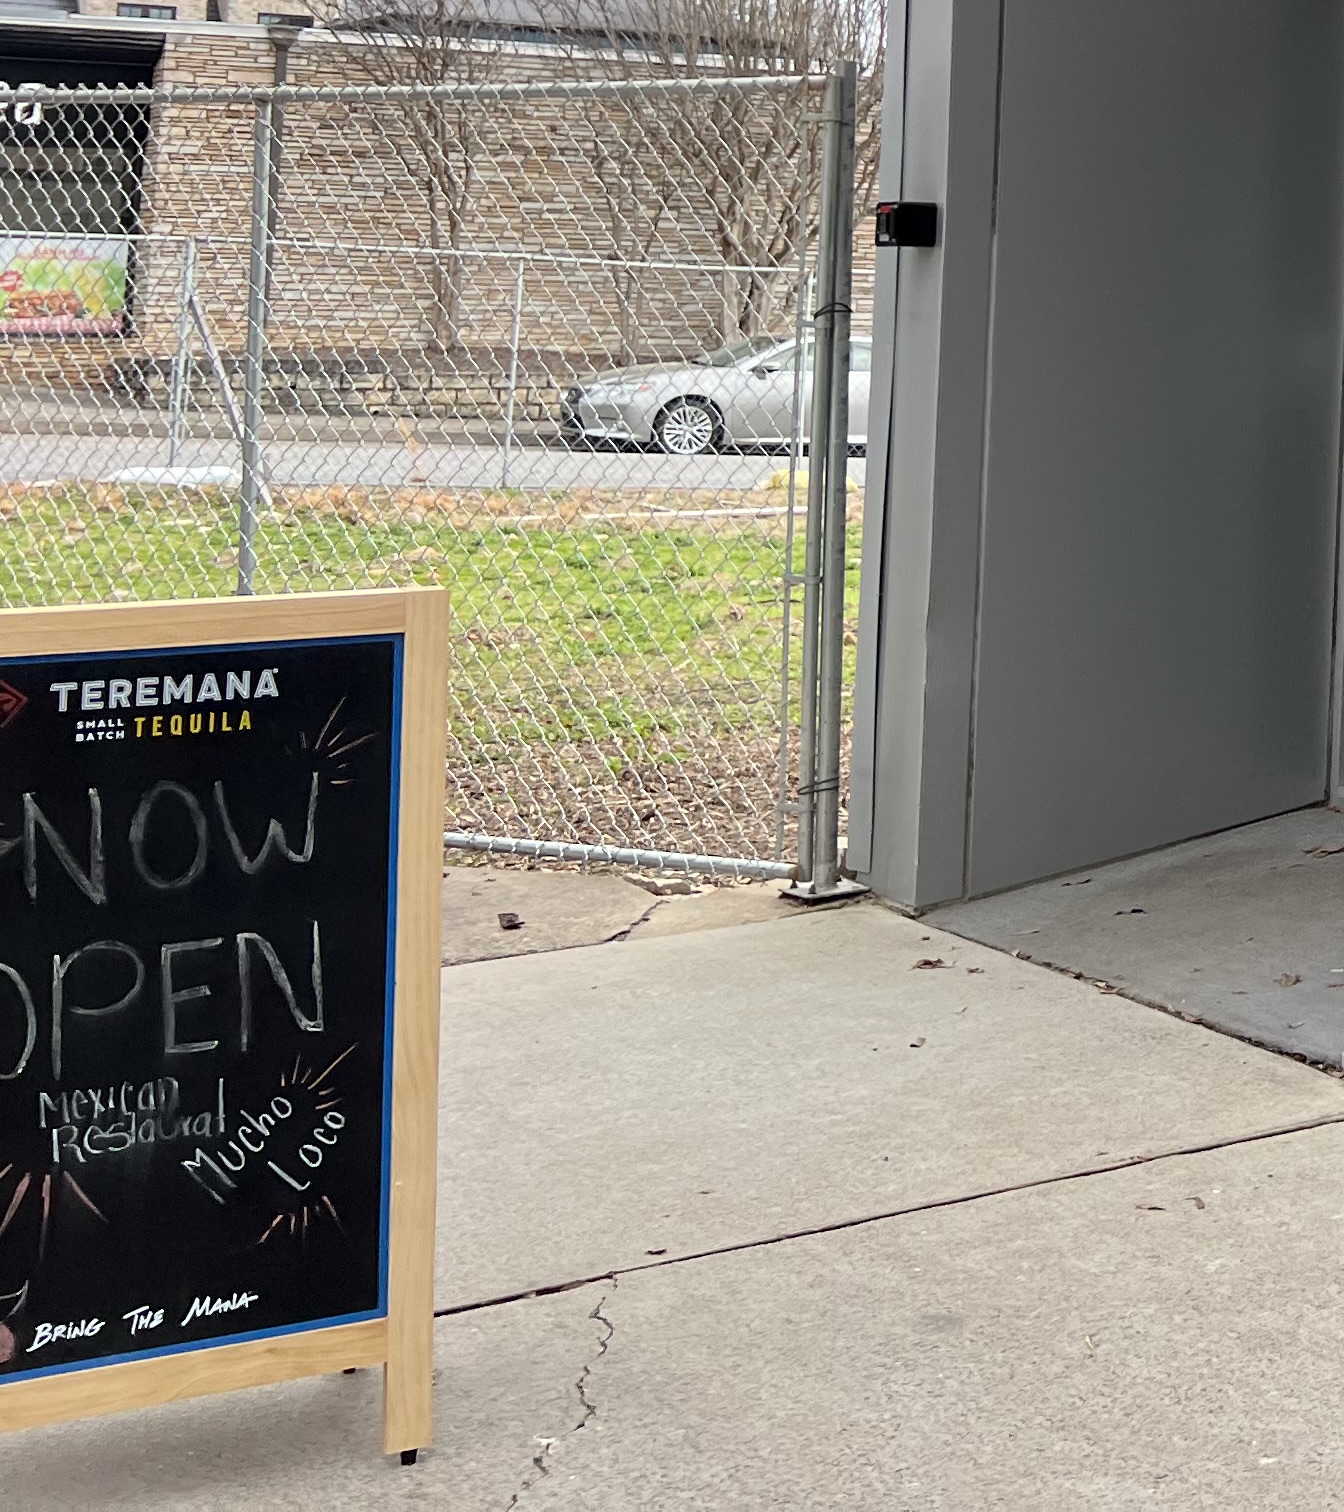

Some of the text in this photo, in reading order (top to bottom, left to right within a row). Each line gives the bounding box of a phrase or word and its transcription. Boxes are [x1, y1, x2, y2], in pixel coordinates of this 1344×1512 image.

[50, 668, 279, 713] TEREMANA
[75, 730, 125, 743] BATCH
[76, 718, 125, 730] SMALL
[134, 709, 252, 738] TEQUILA
[22, 771, 321, 905] NOW
[38, 1076, 180, 1129] Mexican
[180, 1096, 293, 1206] Mucho
[267, 1111, 346, 1192] Loco
[121, 1305, 165, 1336] THE
[180, 1291, 259, 1327] MANA
